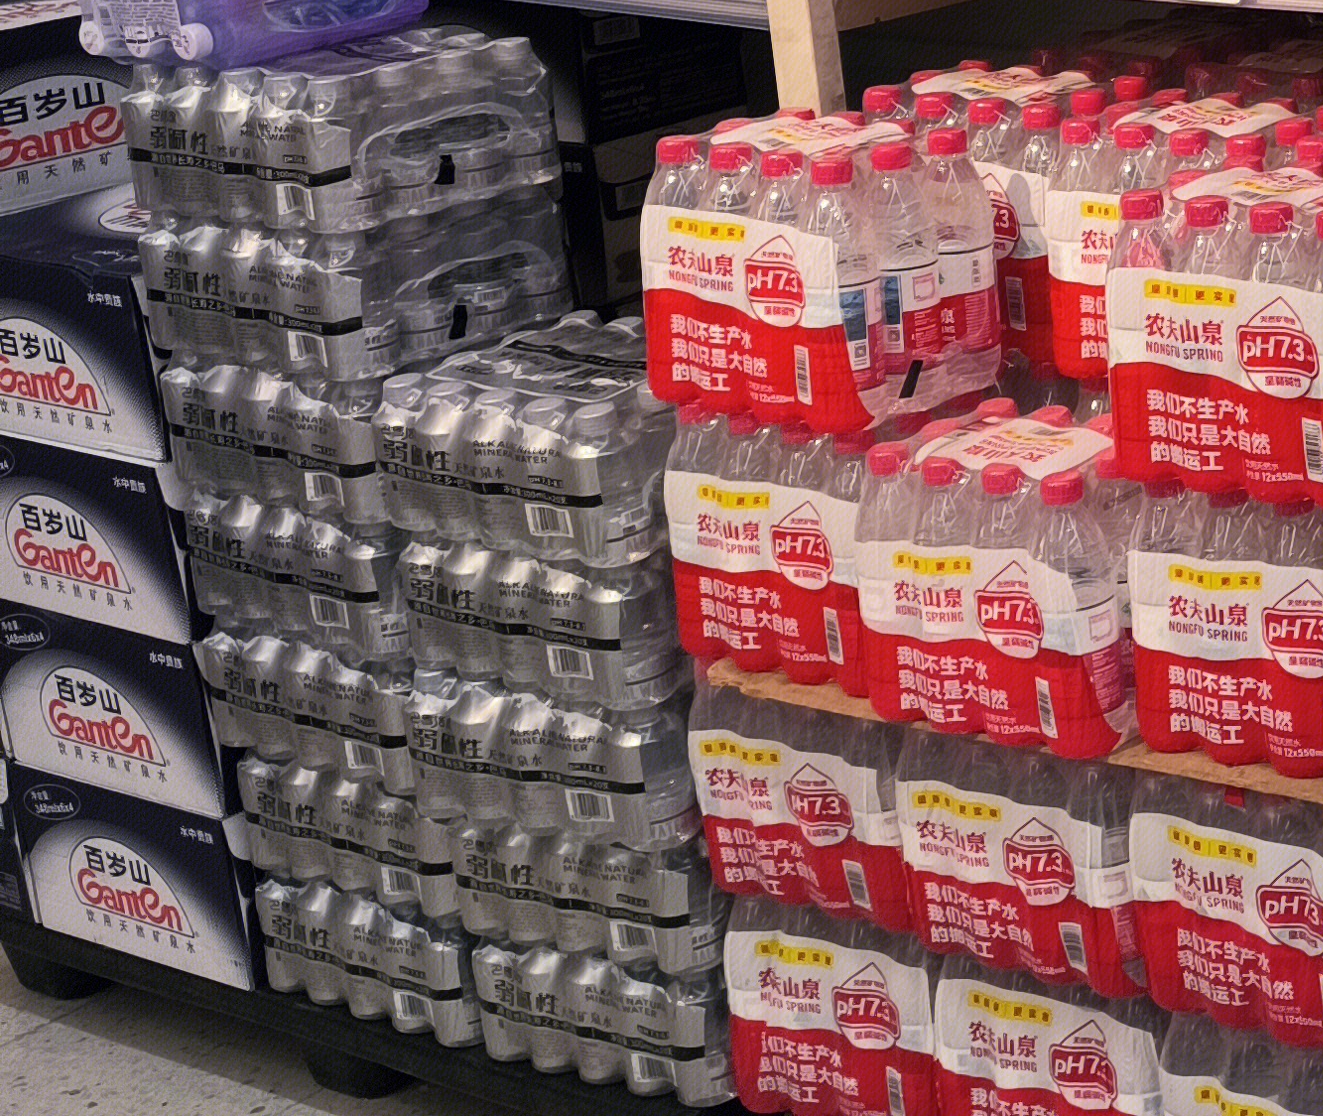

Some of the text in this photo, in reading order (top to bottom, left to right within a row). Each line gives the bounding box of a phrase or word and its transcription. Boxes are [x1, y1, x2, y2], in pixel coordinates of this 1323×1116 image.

[19, 503, 87, 542] 百岁山
[14, 528, 119, 588] Ganten
[55, 676, 120, 713] 百岁山
[49, 702, 154, 759] Ganten
[85, 846, 151, 883] 百岁山
[78, 872, 182, 928] Ganten
